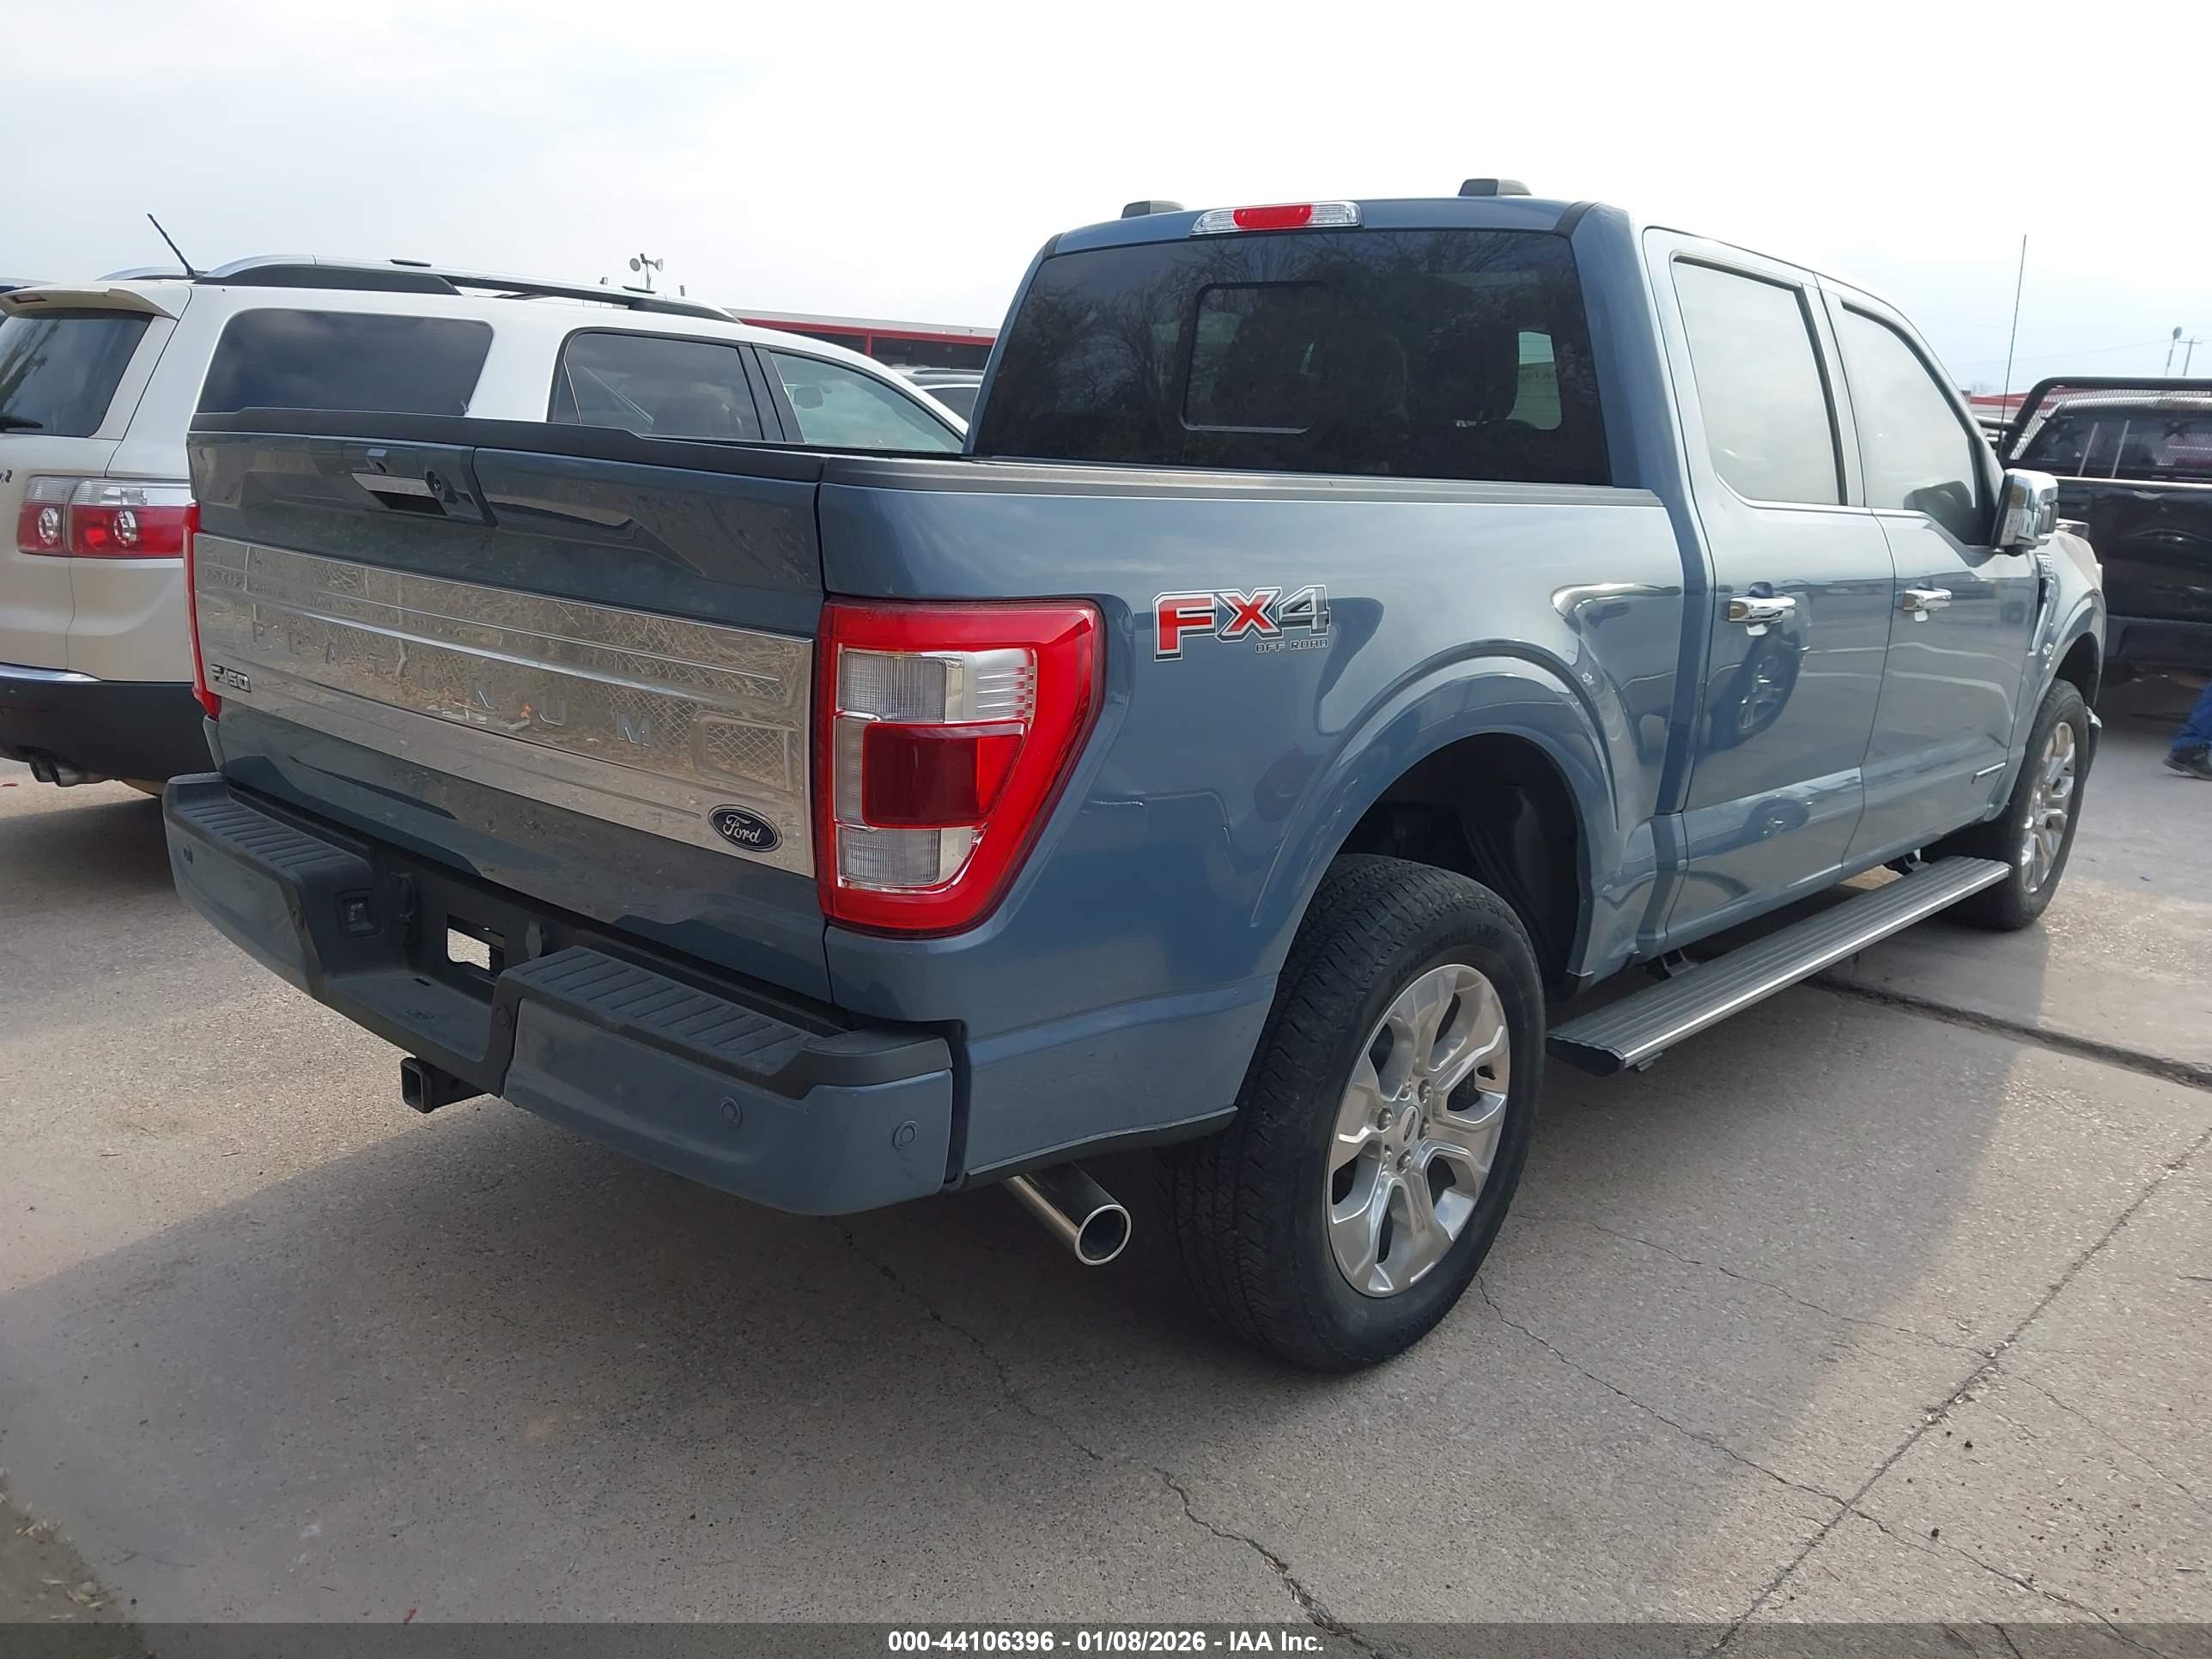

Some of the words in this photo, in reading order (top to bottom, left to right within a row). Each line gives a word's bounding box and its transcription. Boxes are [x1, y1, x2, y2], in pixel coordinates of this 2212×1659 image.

[1152, 584, 1330, 662] FX4
[1255, 641, 1285, 653] OFF
[1291, 638, 1329, 651] ROAD
[252, 620, 653, 747] PLATINUM
[722, 814, 763, 844] Ford
